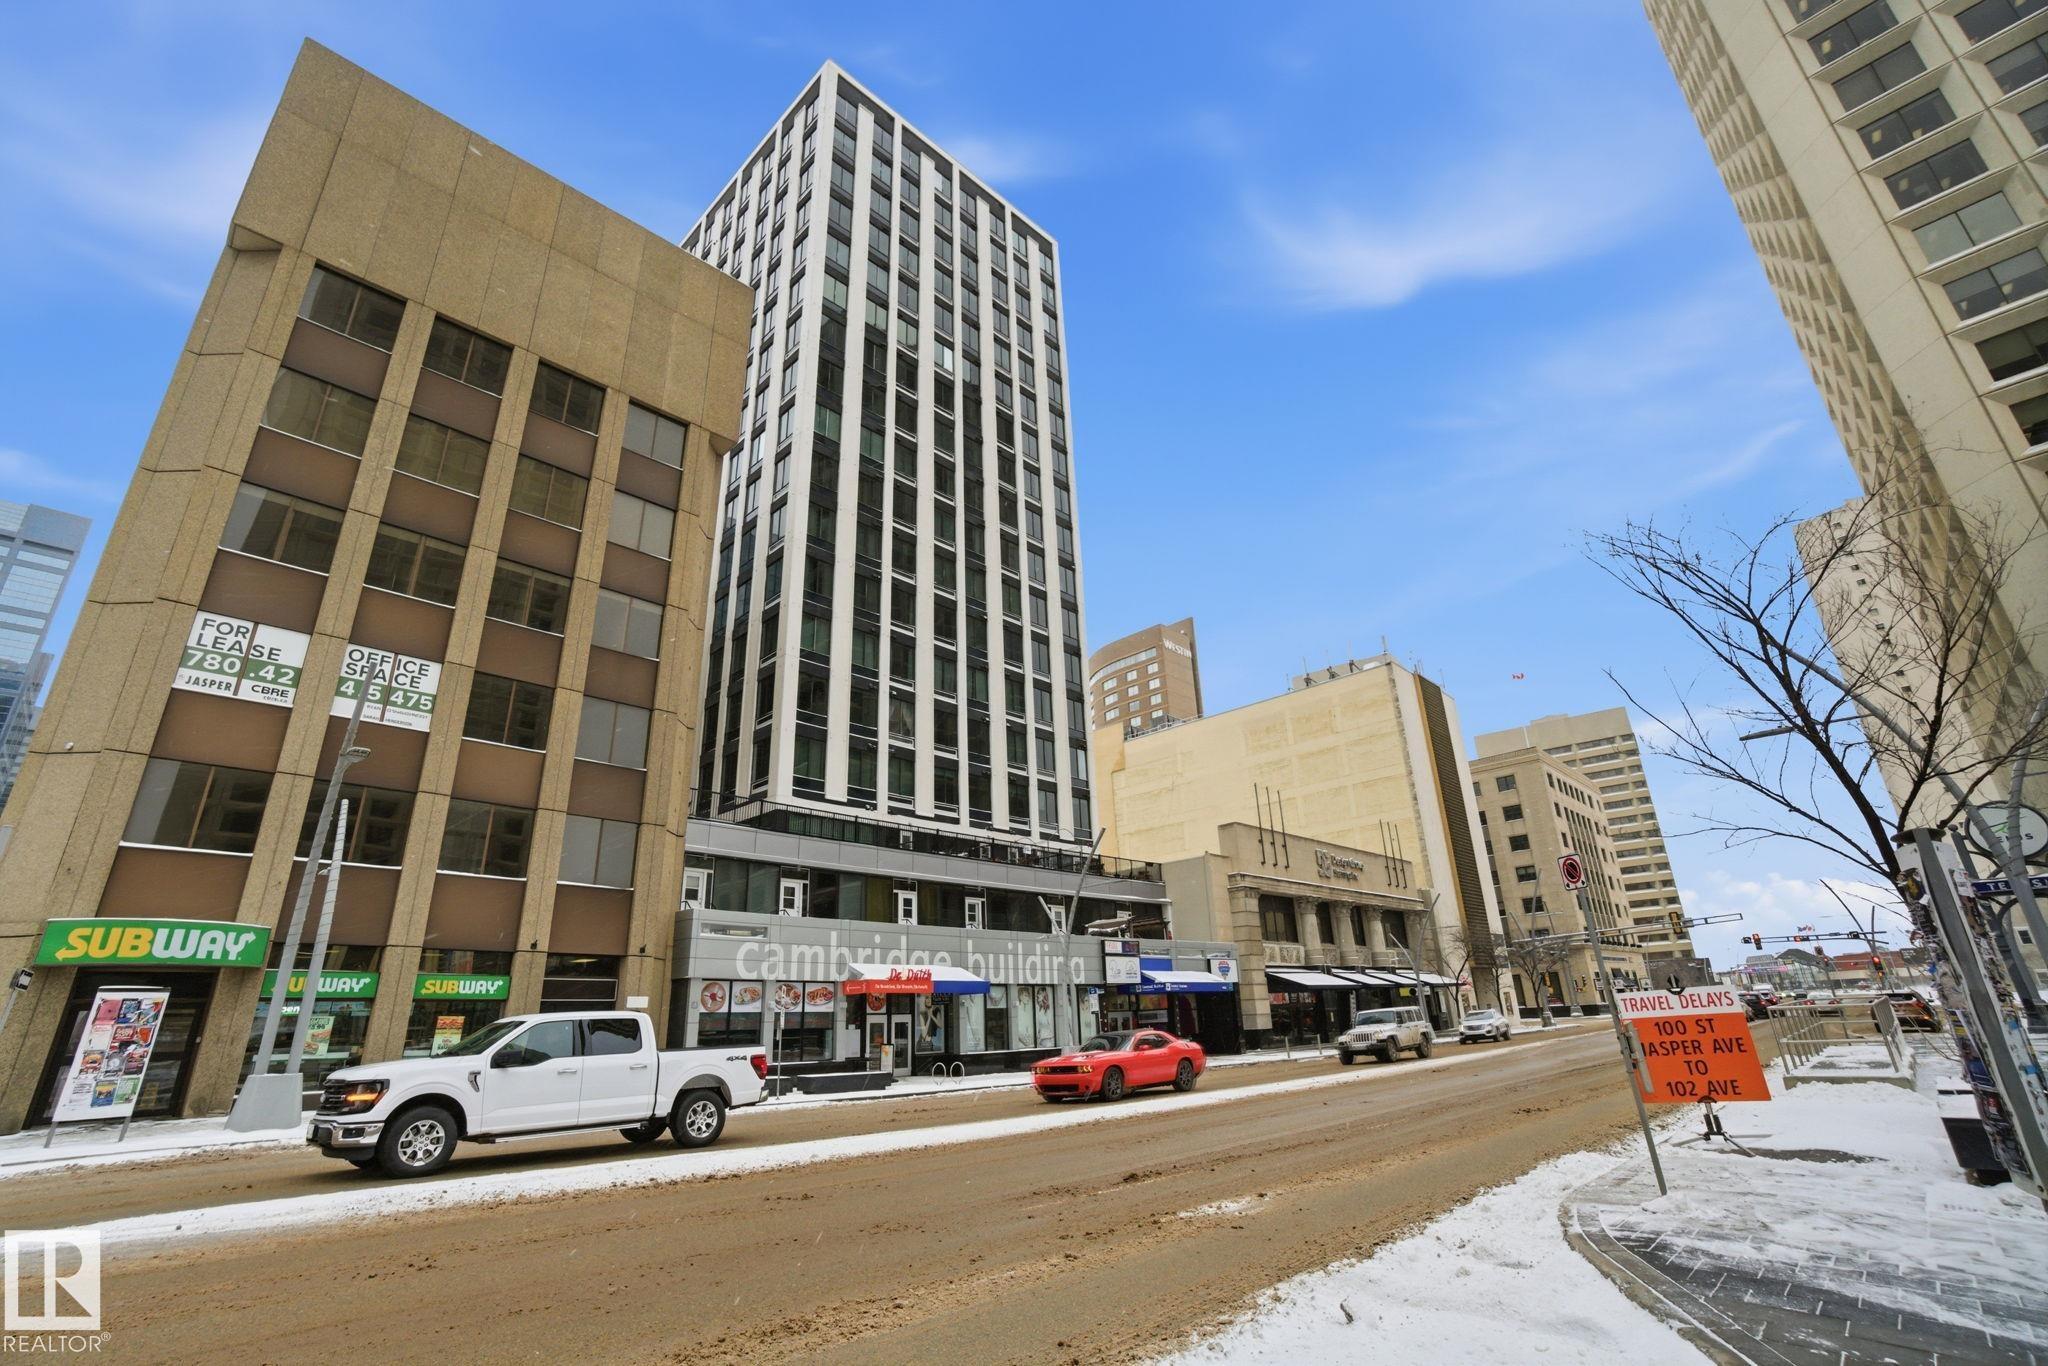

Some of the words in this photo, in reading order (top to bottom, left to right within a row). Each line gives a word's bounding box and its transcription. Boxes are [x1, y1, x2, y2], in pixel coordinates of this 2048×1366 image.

[201, 618, 250, 639] FOR
[196, 633, 281, 661] LEASE
[349, 649, 430, 677] OFFICE
[185, 675, 232, 692] JASPER
[251, 685, 290, 698] CBRE
[54, 927, 257, 962] SUBWAY
[272, 976, 371, 993] UWAY
[421, 979, 504, 995] SUBWAY
[1620, 995, 1674, 1013] TRAVEL
[1678, 991, 1734, 1009] DELAYS
[1654, 1020, 1687, 1036] 100
[1695, 1018, 1715, 1034] ST
[1713, 1037, 1747, 1054] AVE
[1684, 1060, 1708, 1076] TO
[1666, 1081, 1698, 1097] 102
[1707, 1079, 1742, 1096] AVE
